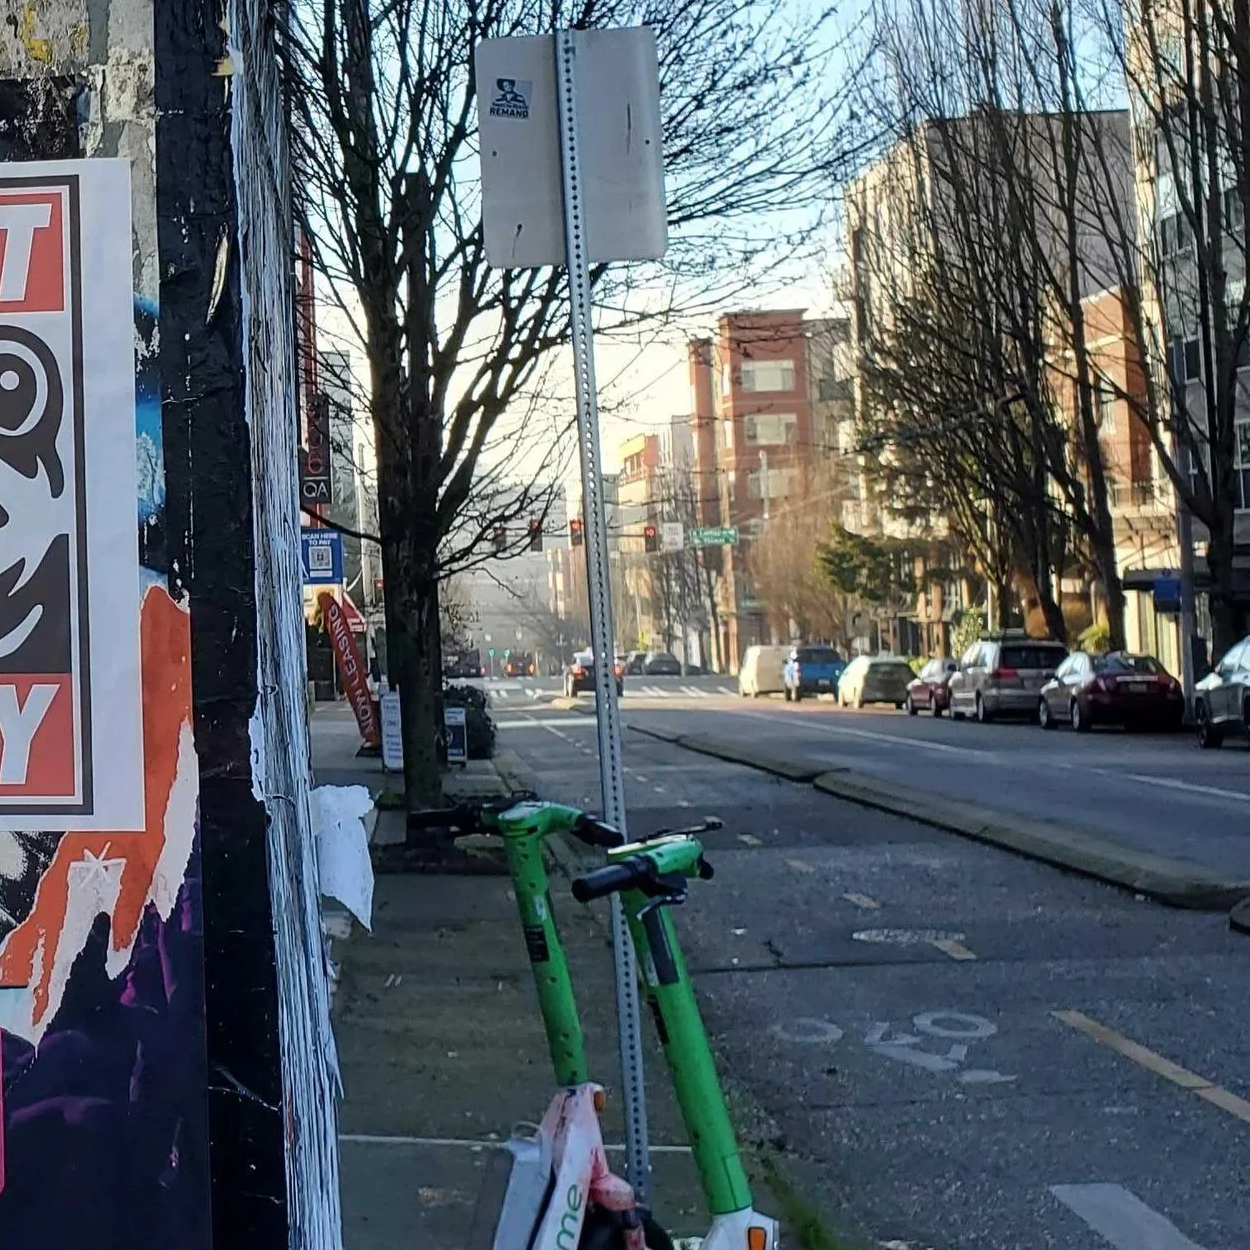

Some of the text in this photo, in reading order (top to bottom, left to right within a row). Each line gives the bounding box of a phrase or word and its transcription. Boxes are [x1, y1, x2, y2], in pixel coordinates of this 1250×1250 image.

[303, 482, 328, 498] QA
[328, 603, 360, 688] LEASING
[354, 688, 375, 734] NOW
